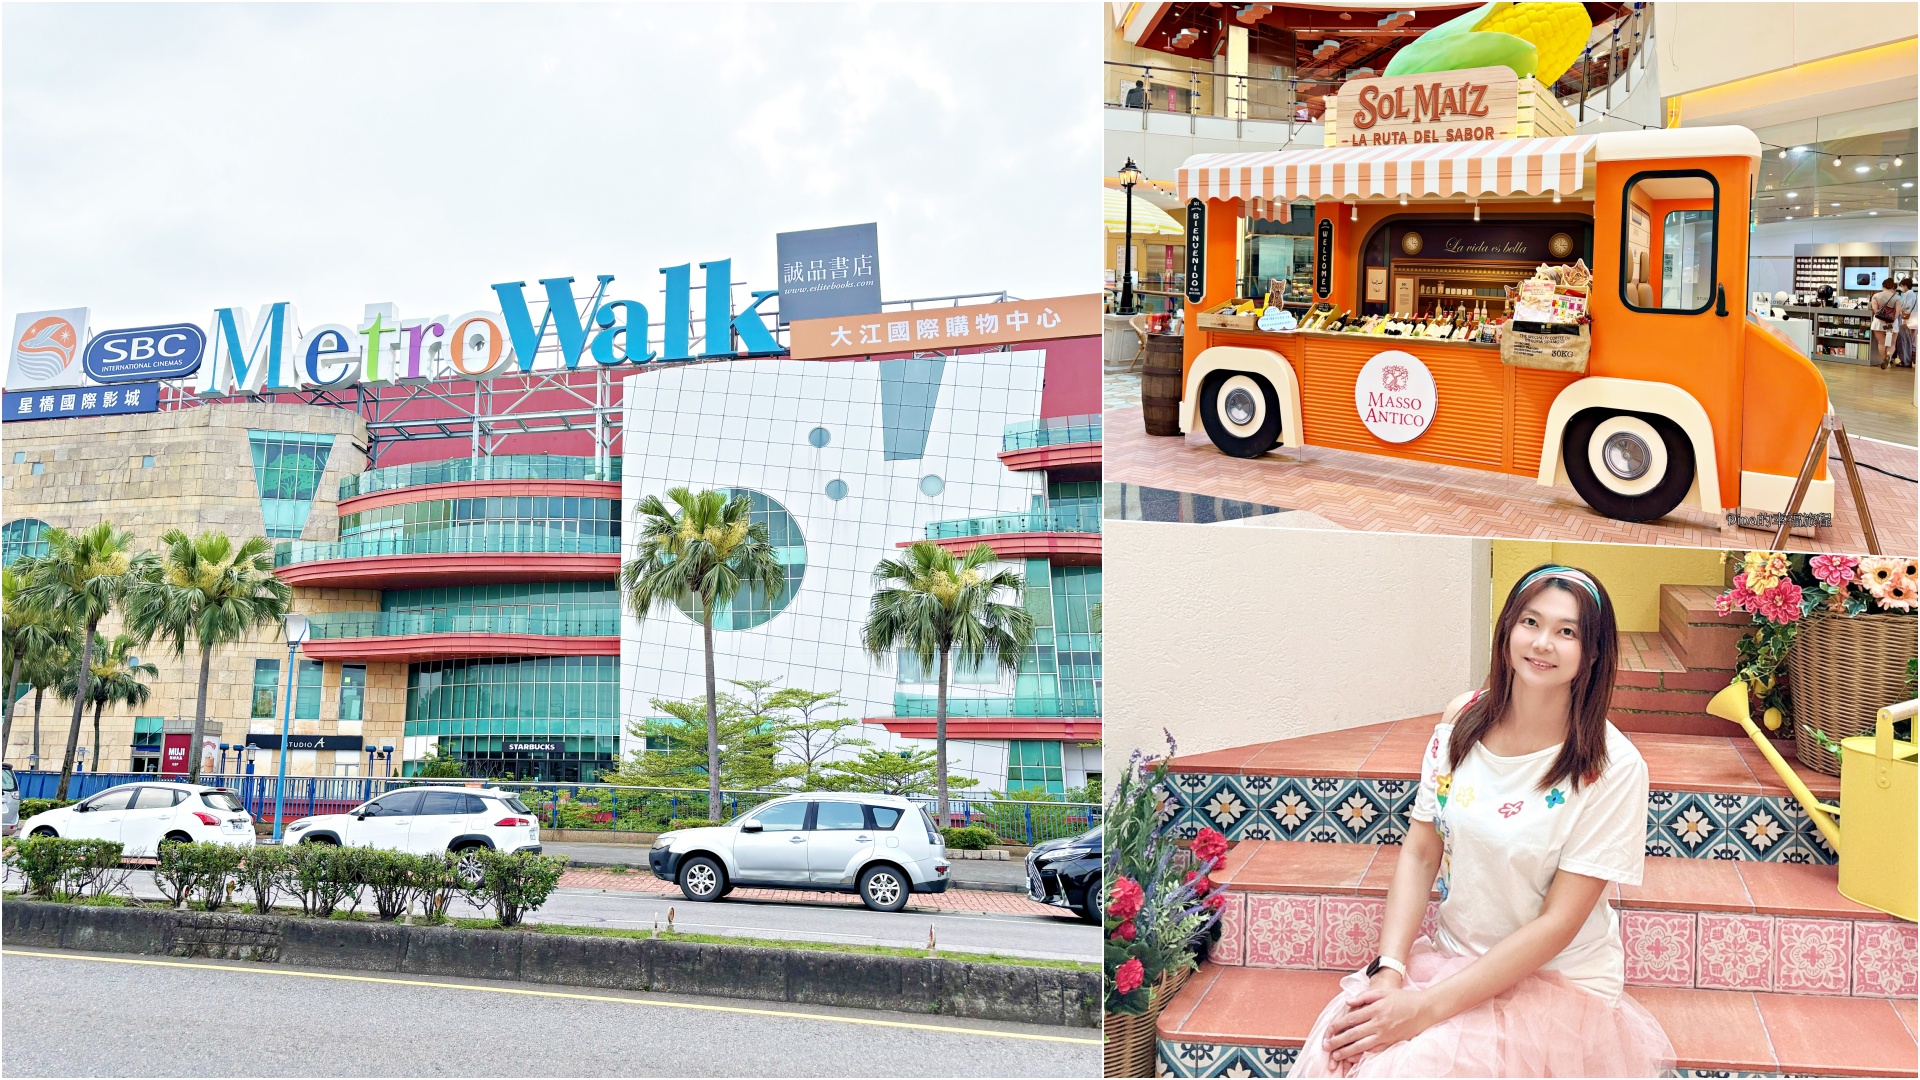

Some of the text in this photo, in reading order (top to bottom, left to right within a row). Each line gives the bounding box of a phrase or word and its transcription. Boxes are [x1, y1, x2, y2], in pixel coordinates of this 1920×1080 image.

[1353, 82, 1489, 129] SOL MAÍZ
[1352, 126, 1495, 146] LA RUTA DEL SABOR
[1191, 212, 1200, 287] BIENVENIDO
[1444, 237, 1528, 254] La vida es bella
[1321, 230, 1329, 285] WELCOME
[783, 254, 873, 283] 誠品書店
[784, 279, 874, 295] www.eslitebooks.com
[830, 307, 1062, 347] 大江國際購物中心
[102, 333, 187, 364] SBC
[101, 359, 183, 372] INTERNATIONAL CINEMAS
[17, 389, 141, 414] 星橋國際影城
[1368, 391, 1422, 411] MASSO
[1365, 407, 1425, 427] ANTICO
[168, 747, 186, 756] MUJI
[313, 737, 325, 748] A
[508, 743, 556, 751] STARBUCKS
